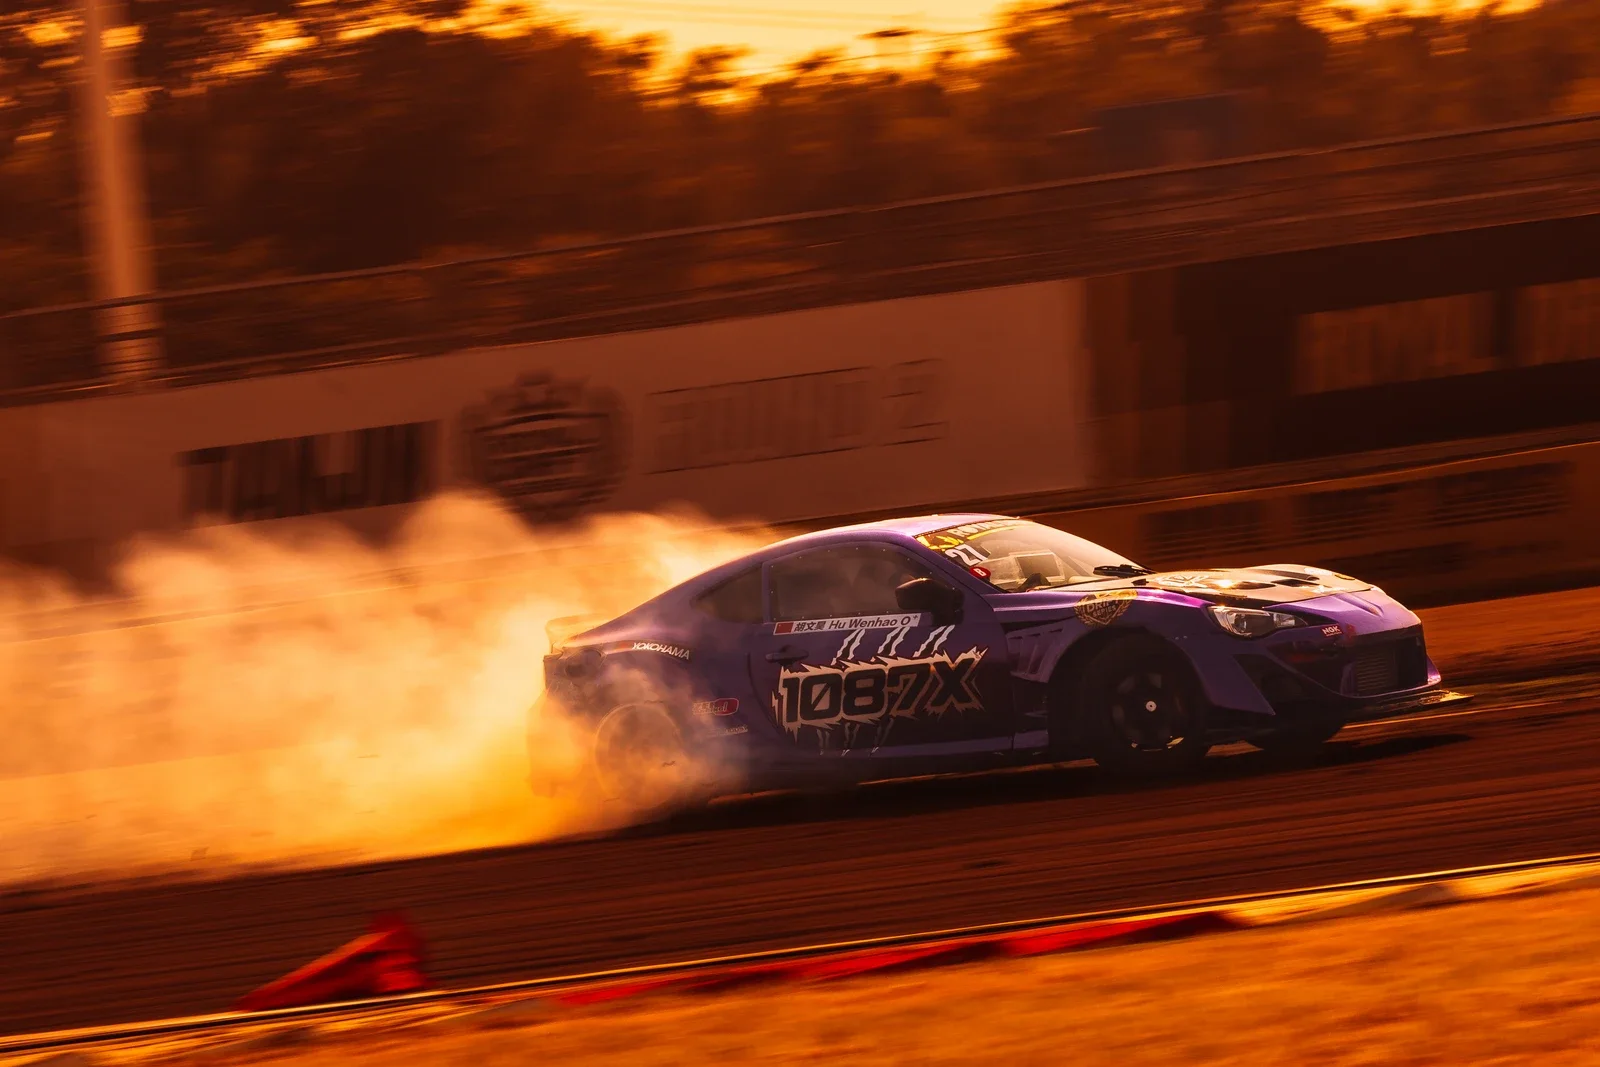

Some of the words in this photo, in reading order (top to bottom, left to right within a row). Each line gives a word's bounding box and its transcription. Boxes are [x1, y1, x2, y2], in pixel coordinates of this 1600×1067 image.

[945, 544, 988, 567] 27
[828, 620, 846, 630] Hu
[850, 617, 898, 629] Wenhao
[631, 642, 690, 660] YOKOHAMA
[777, 652, 983, 726] 1087X
